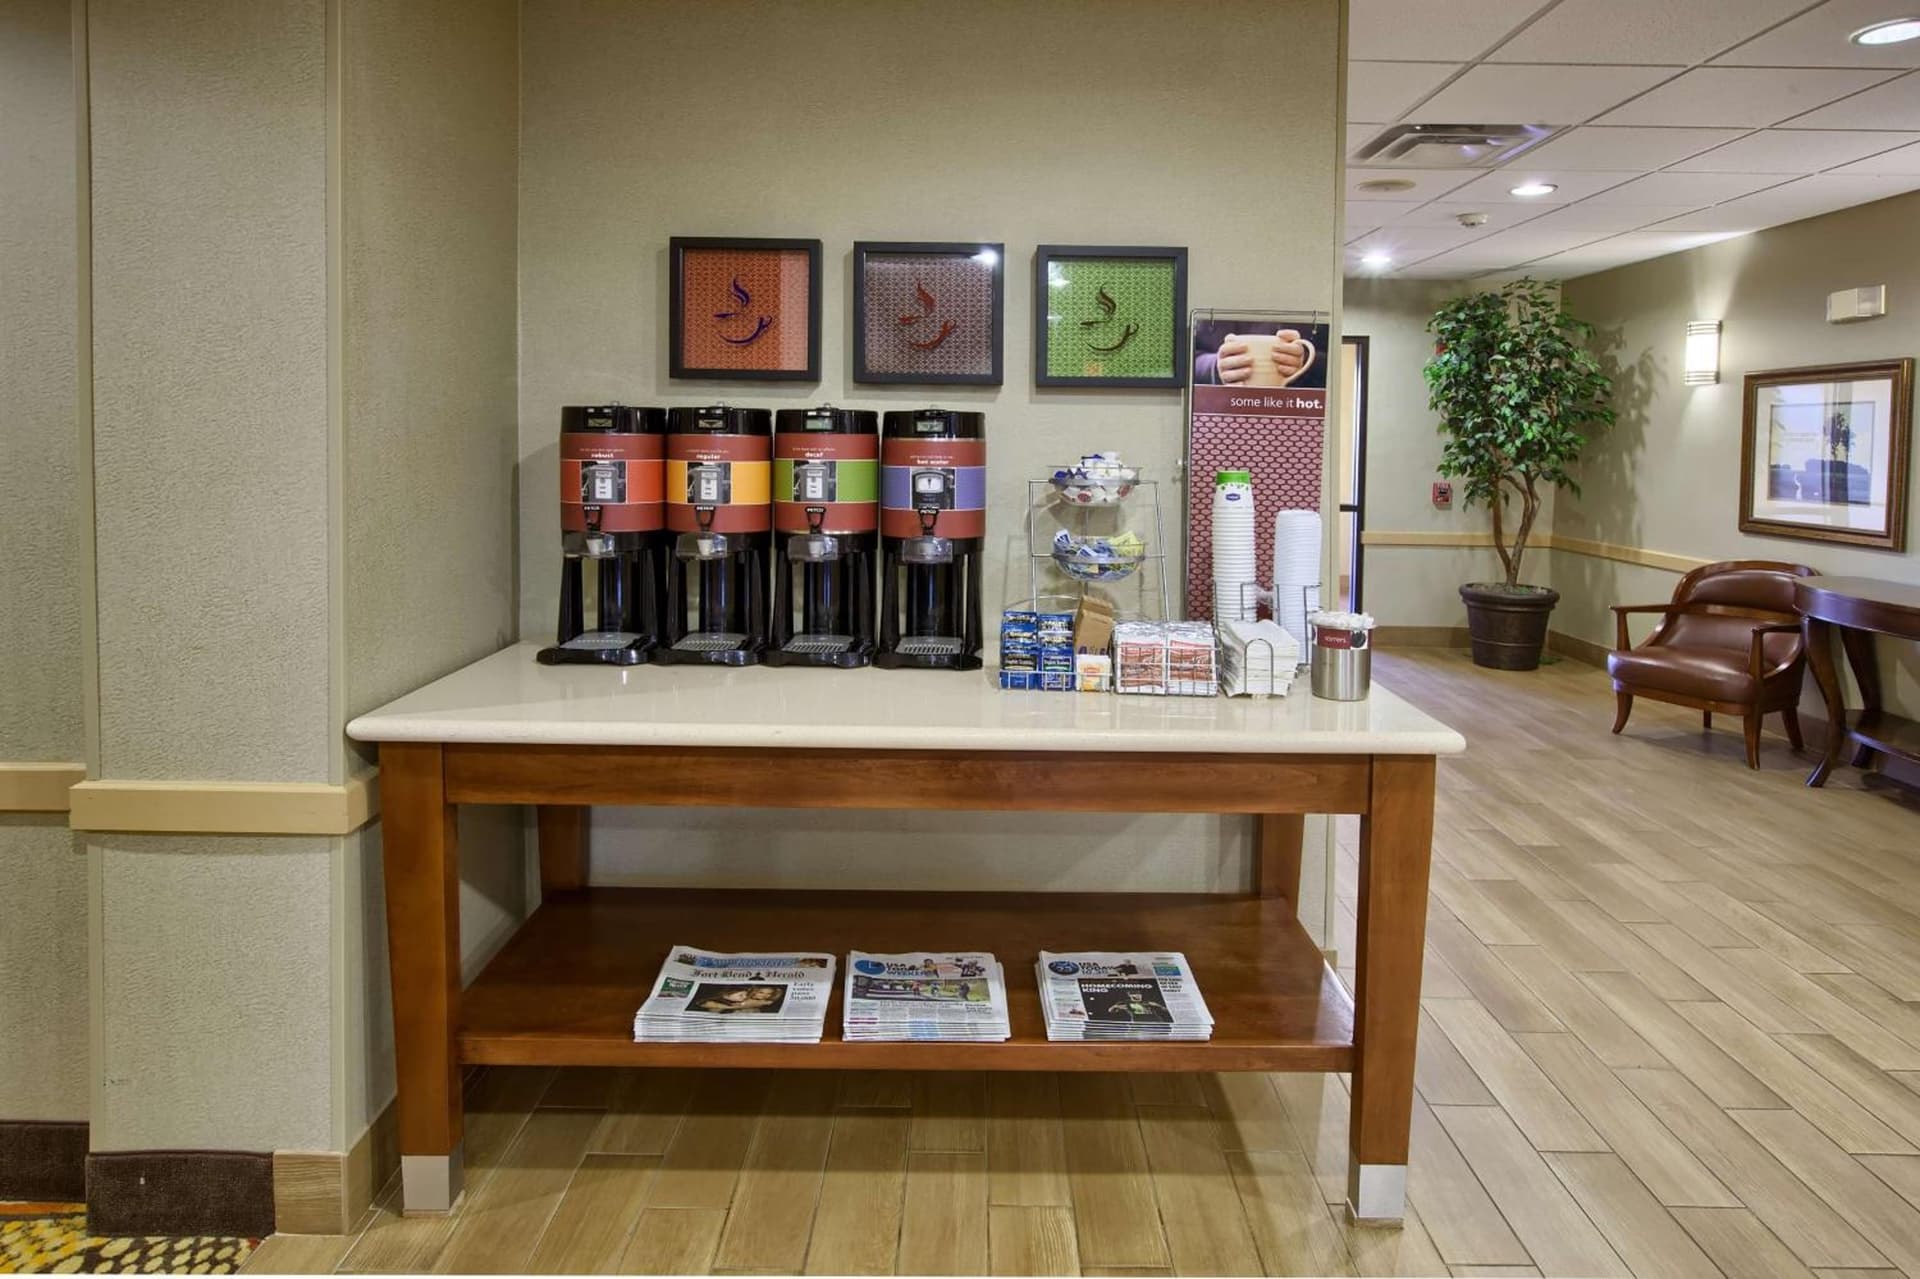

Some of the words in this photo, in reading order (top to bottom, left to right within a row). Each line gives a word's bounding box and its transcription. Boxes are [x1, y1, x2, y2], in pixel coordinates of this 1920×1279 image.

[1230, 397, 1261, 407] some
[1263, 396, 1283, 407] like
[1286, 397, 1293, 408] it
[1296, 398, 1323, 409] hot.
